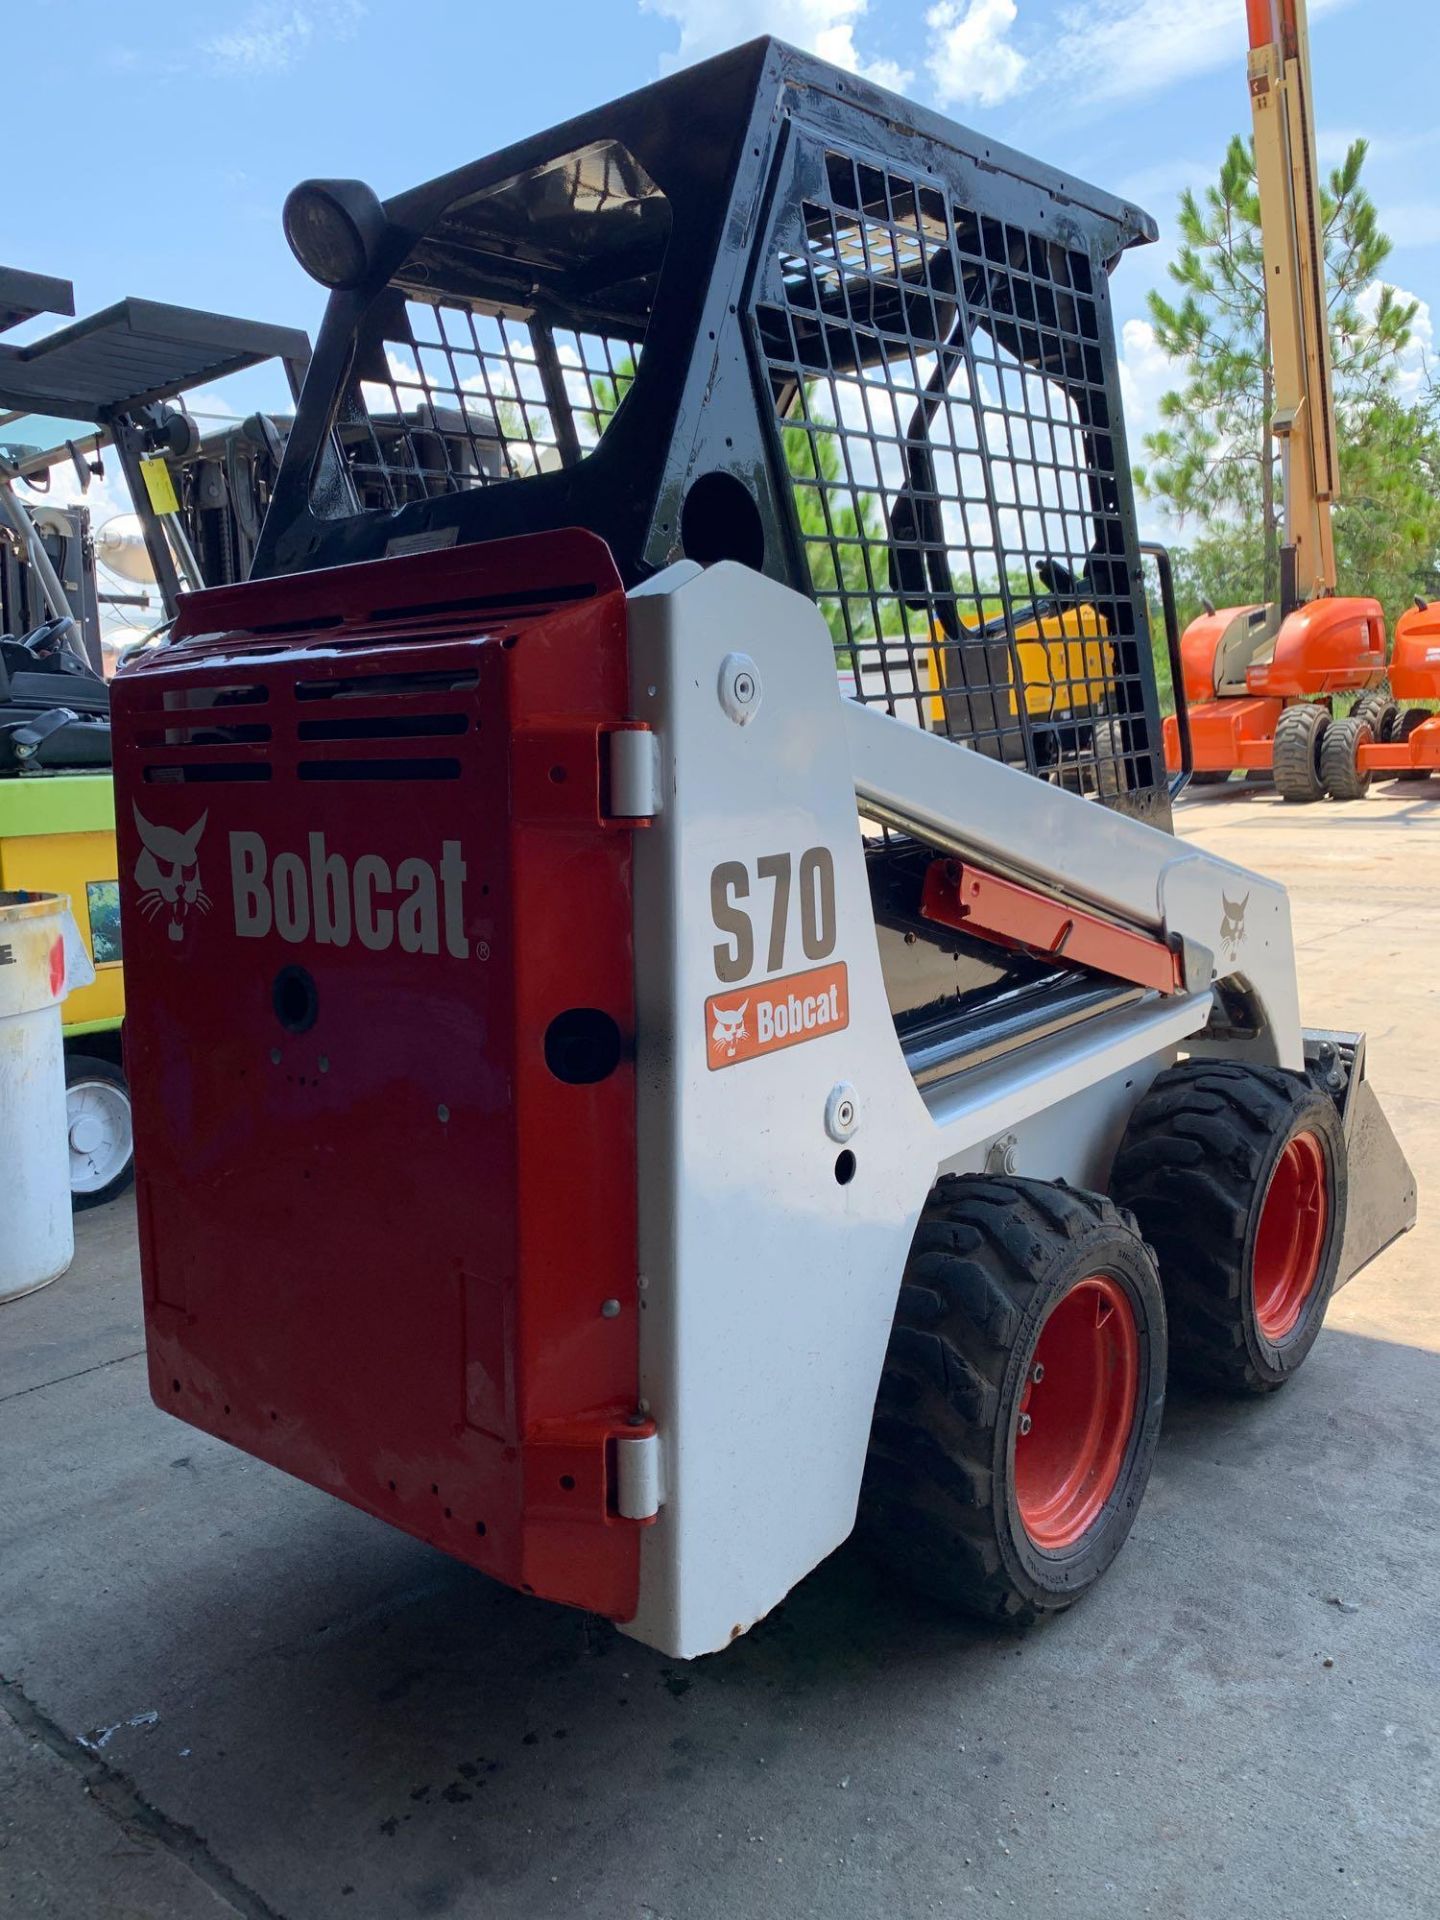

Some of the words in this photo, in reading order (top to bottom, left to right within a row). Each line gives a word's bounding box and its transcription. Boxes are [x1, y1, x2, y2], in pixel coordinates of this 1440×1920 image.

[229, 831, 469, 959] Bobcat
[710, 846, 837, 983] S70
[757, 984, 839, 1043] Bobcat
